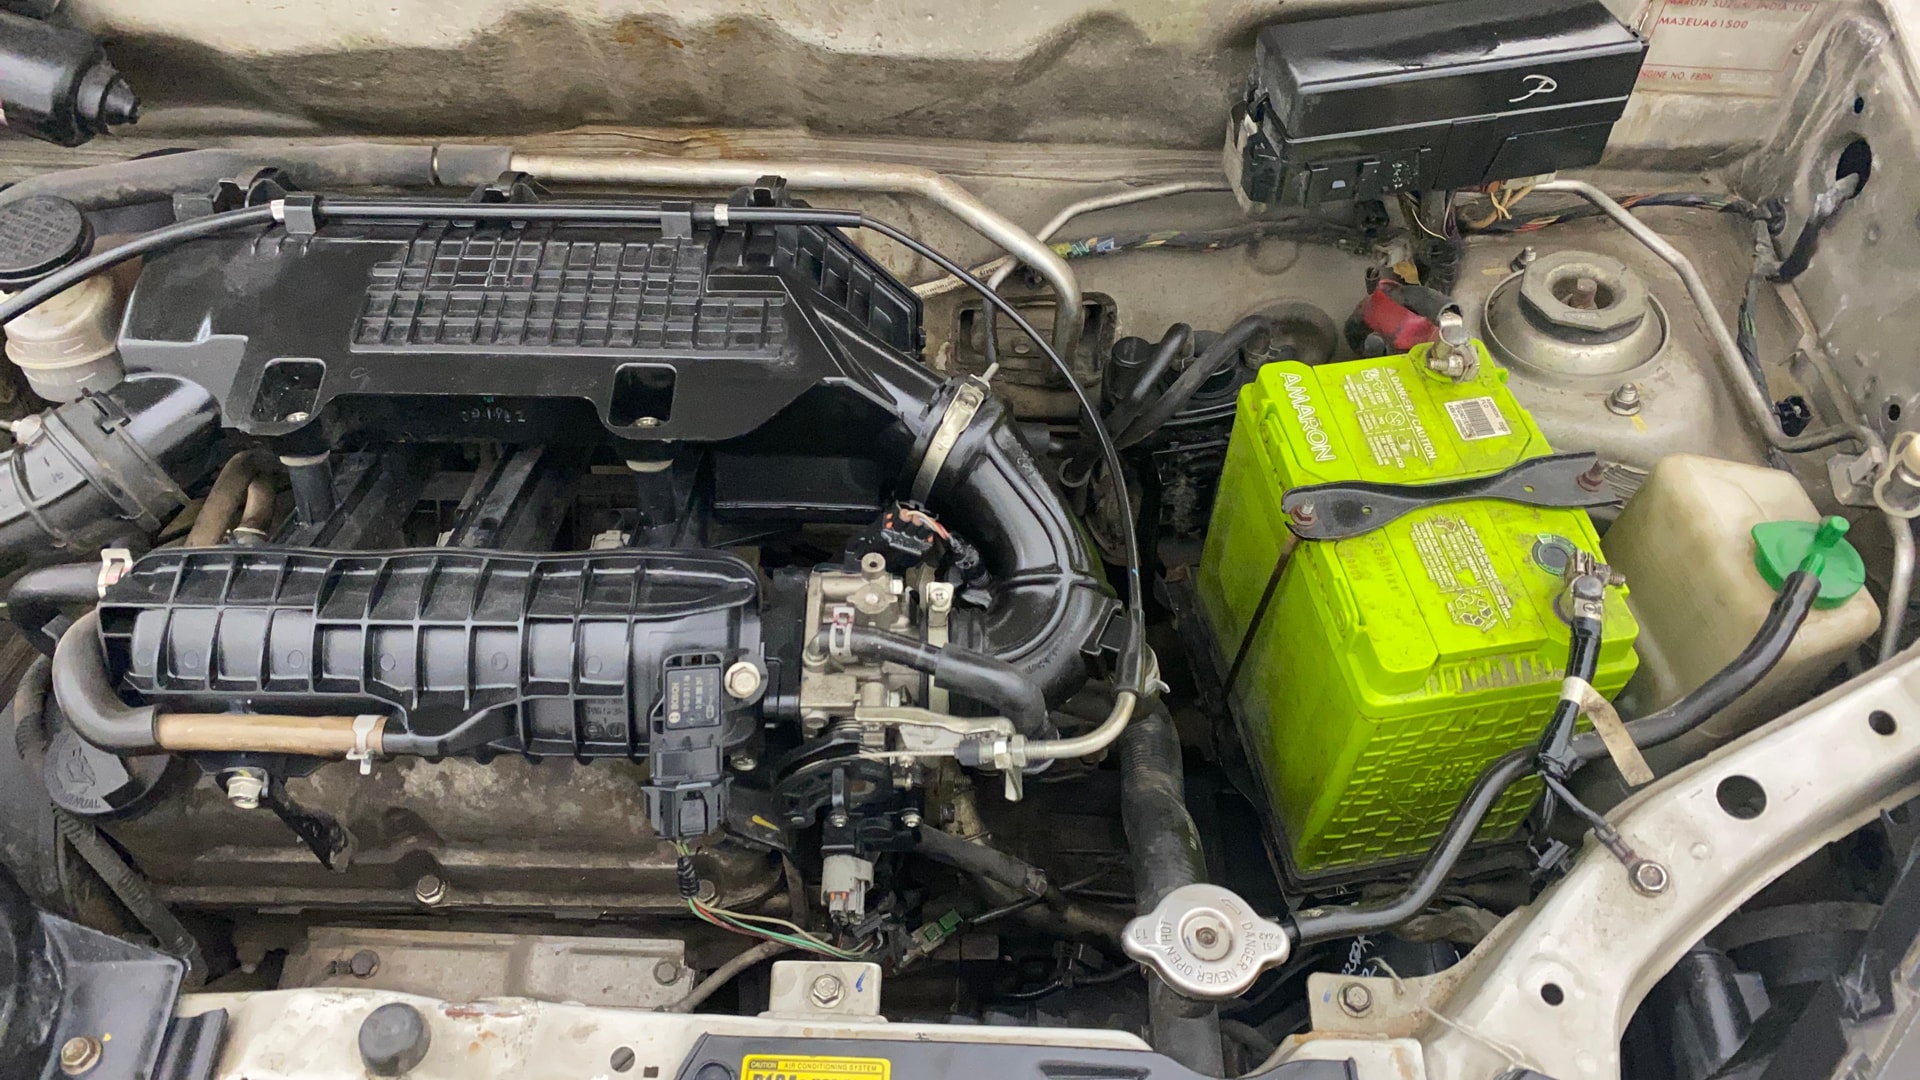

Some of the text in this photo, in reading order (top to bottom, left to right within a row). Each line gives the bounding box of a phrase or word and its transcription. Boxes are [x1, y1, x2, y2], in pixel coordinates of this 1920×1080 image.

[1640, 70, 1668, 79] NGINE
[1279, 372, 1337, 462] AMARON
[1390, 376, 1414, 411] DANGER
[1412, 418, 1437, 459] CAUTION
[1160, 920, 1256, 984] DANGER NEVER OPEN HOT
[797, 1062, 848, 1071] CONDITIONING
